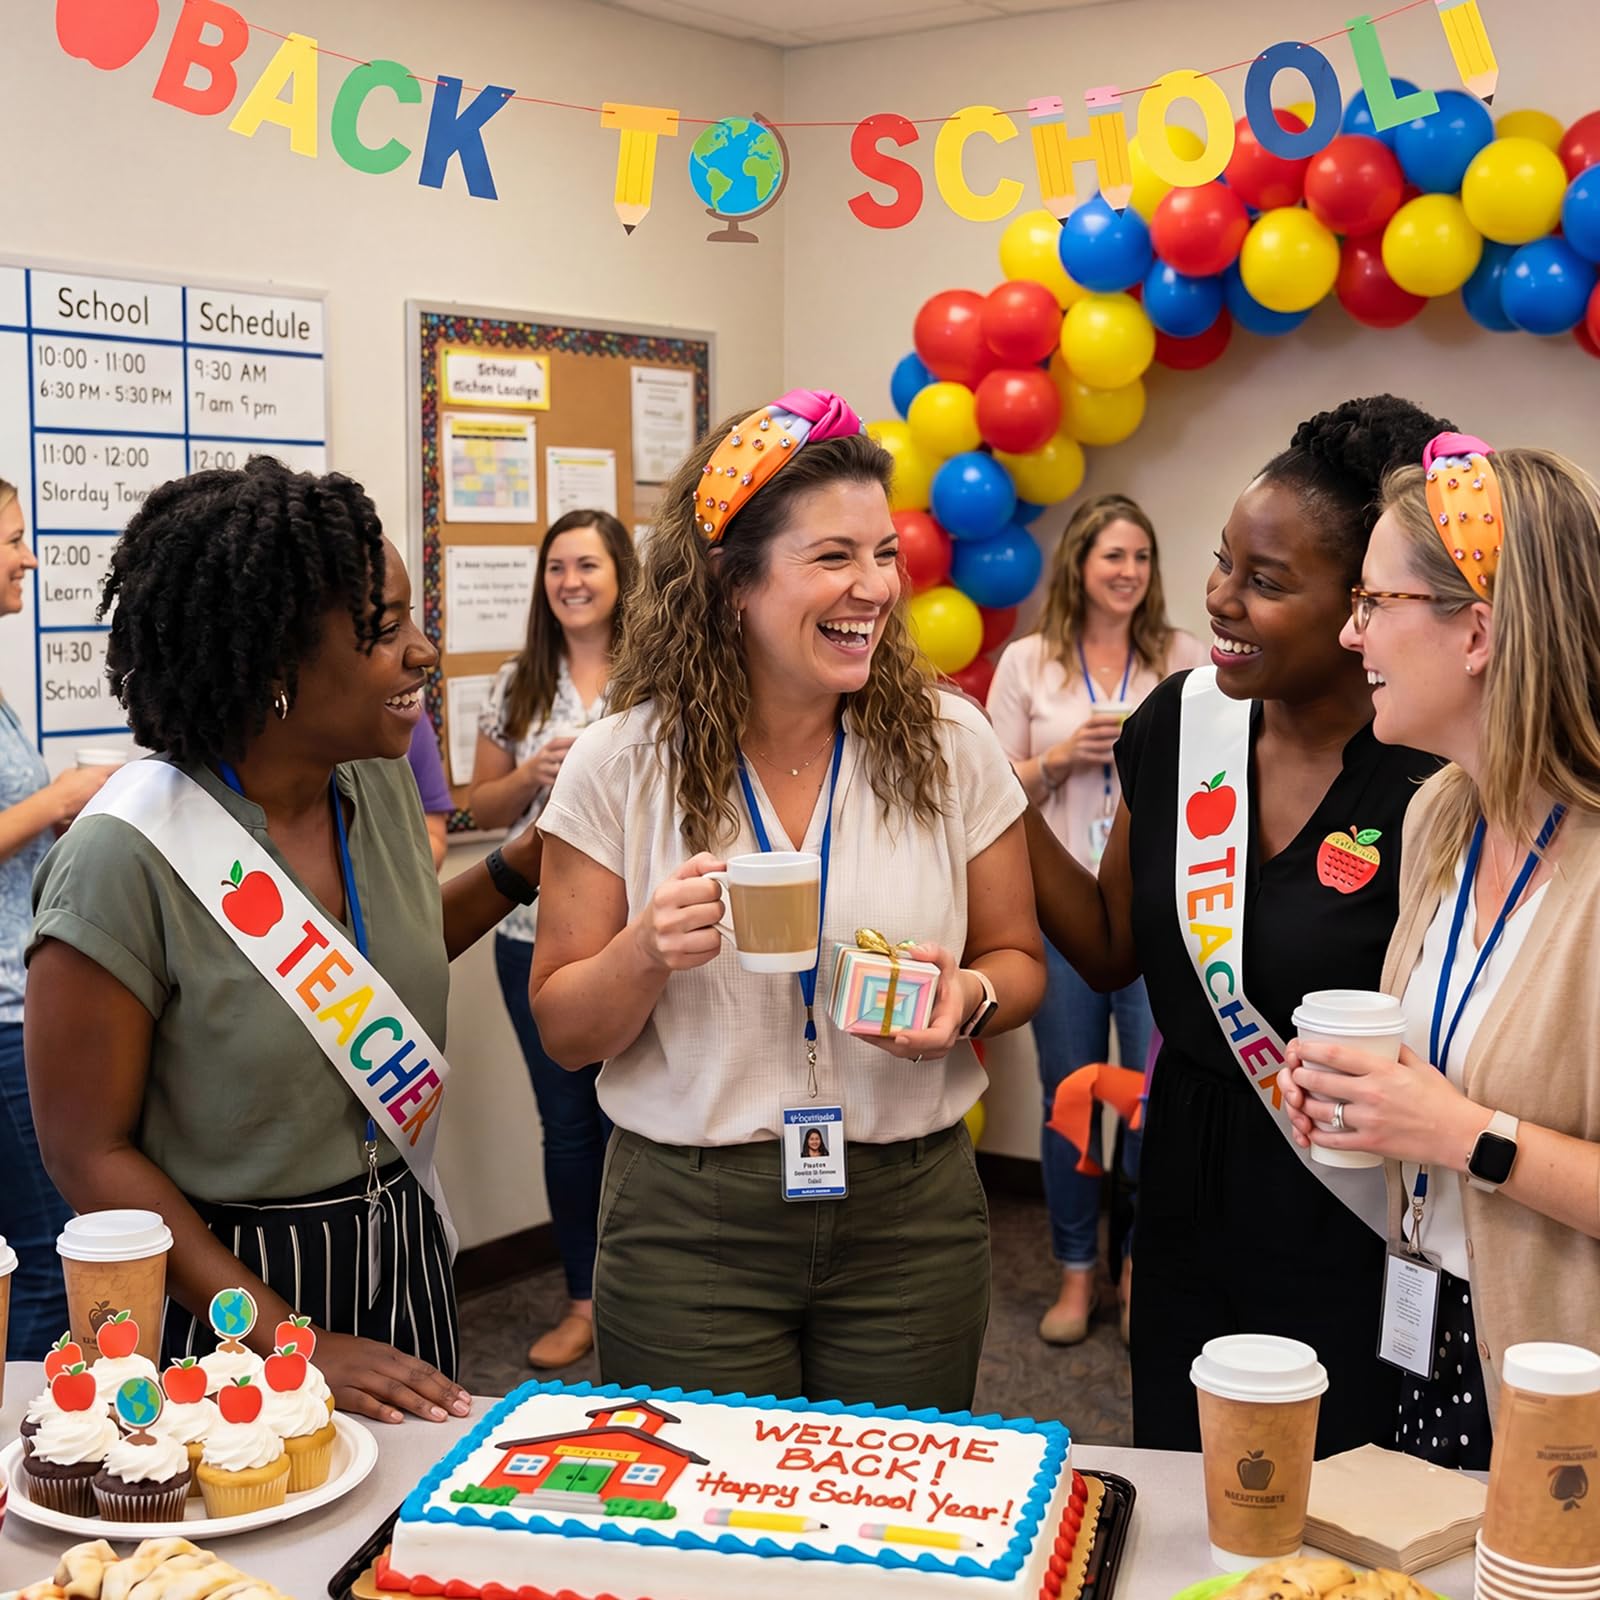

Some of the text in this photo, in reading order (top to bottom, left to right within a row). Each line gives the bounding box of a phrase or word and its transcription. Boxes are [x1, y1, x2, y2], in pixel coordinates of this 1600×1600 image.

[153, 0, 517, 202] BACK
[58, 287, 149, 326] School
[199, 302, 311, 341] Schedule
[38, 345, 88, 370] 10:00
[106, 351, 146, 374] 11:00
[194, 359, 267, 383] 9:30 AM
[40, 379, 76, 399] 6:30
[79, 382, 101, 400] PM
[115, 385, 148, 404] 5:30
[151, 387, 172, 406] PM
[42, 443, 87, 467] 11:00
[105, 446, 150, 468] 12:00
[194, 450, 236, 471] 12:00
[44, 544, 92, 567] 12:00
[45, 581, 93, 602] Learn
[47, 641, 93, 665] 14:30
[45, 679, 102, 702] School
[276, 919, 444, 1147] TEACHER
[755, 1420, 999, 1463] WELCOME
[696, 1471, 1015, 1527] Happy School Year!
